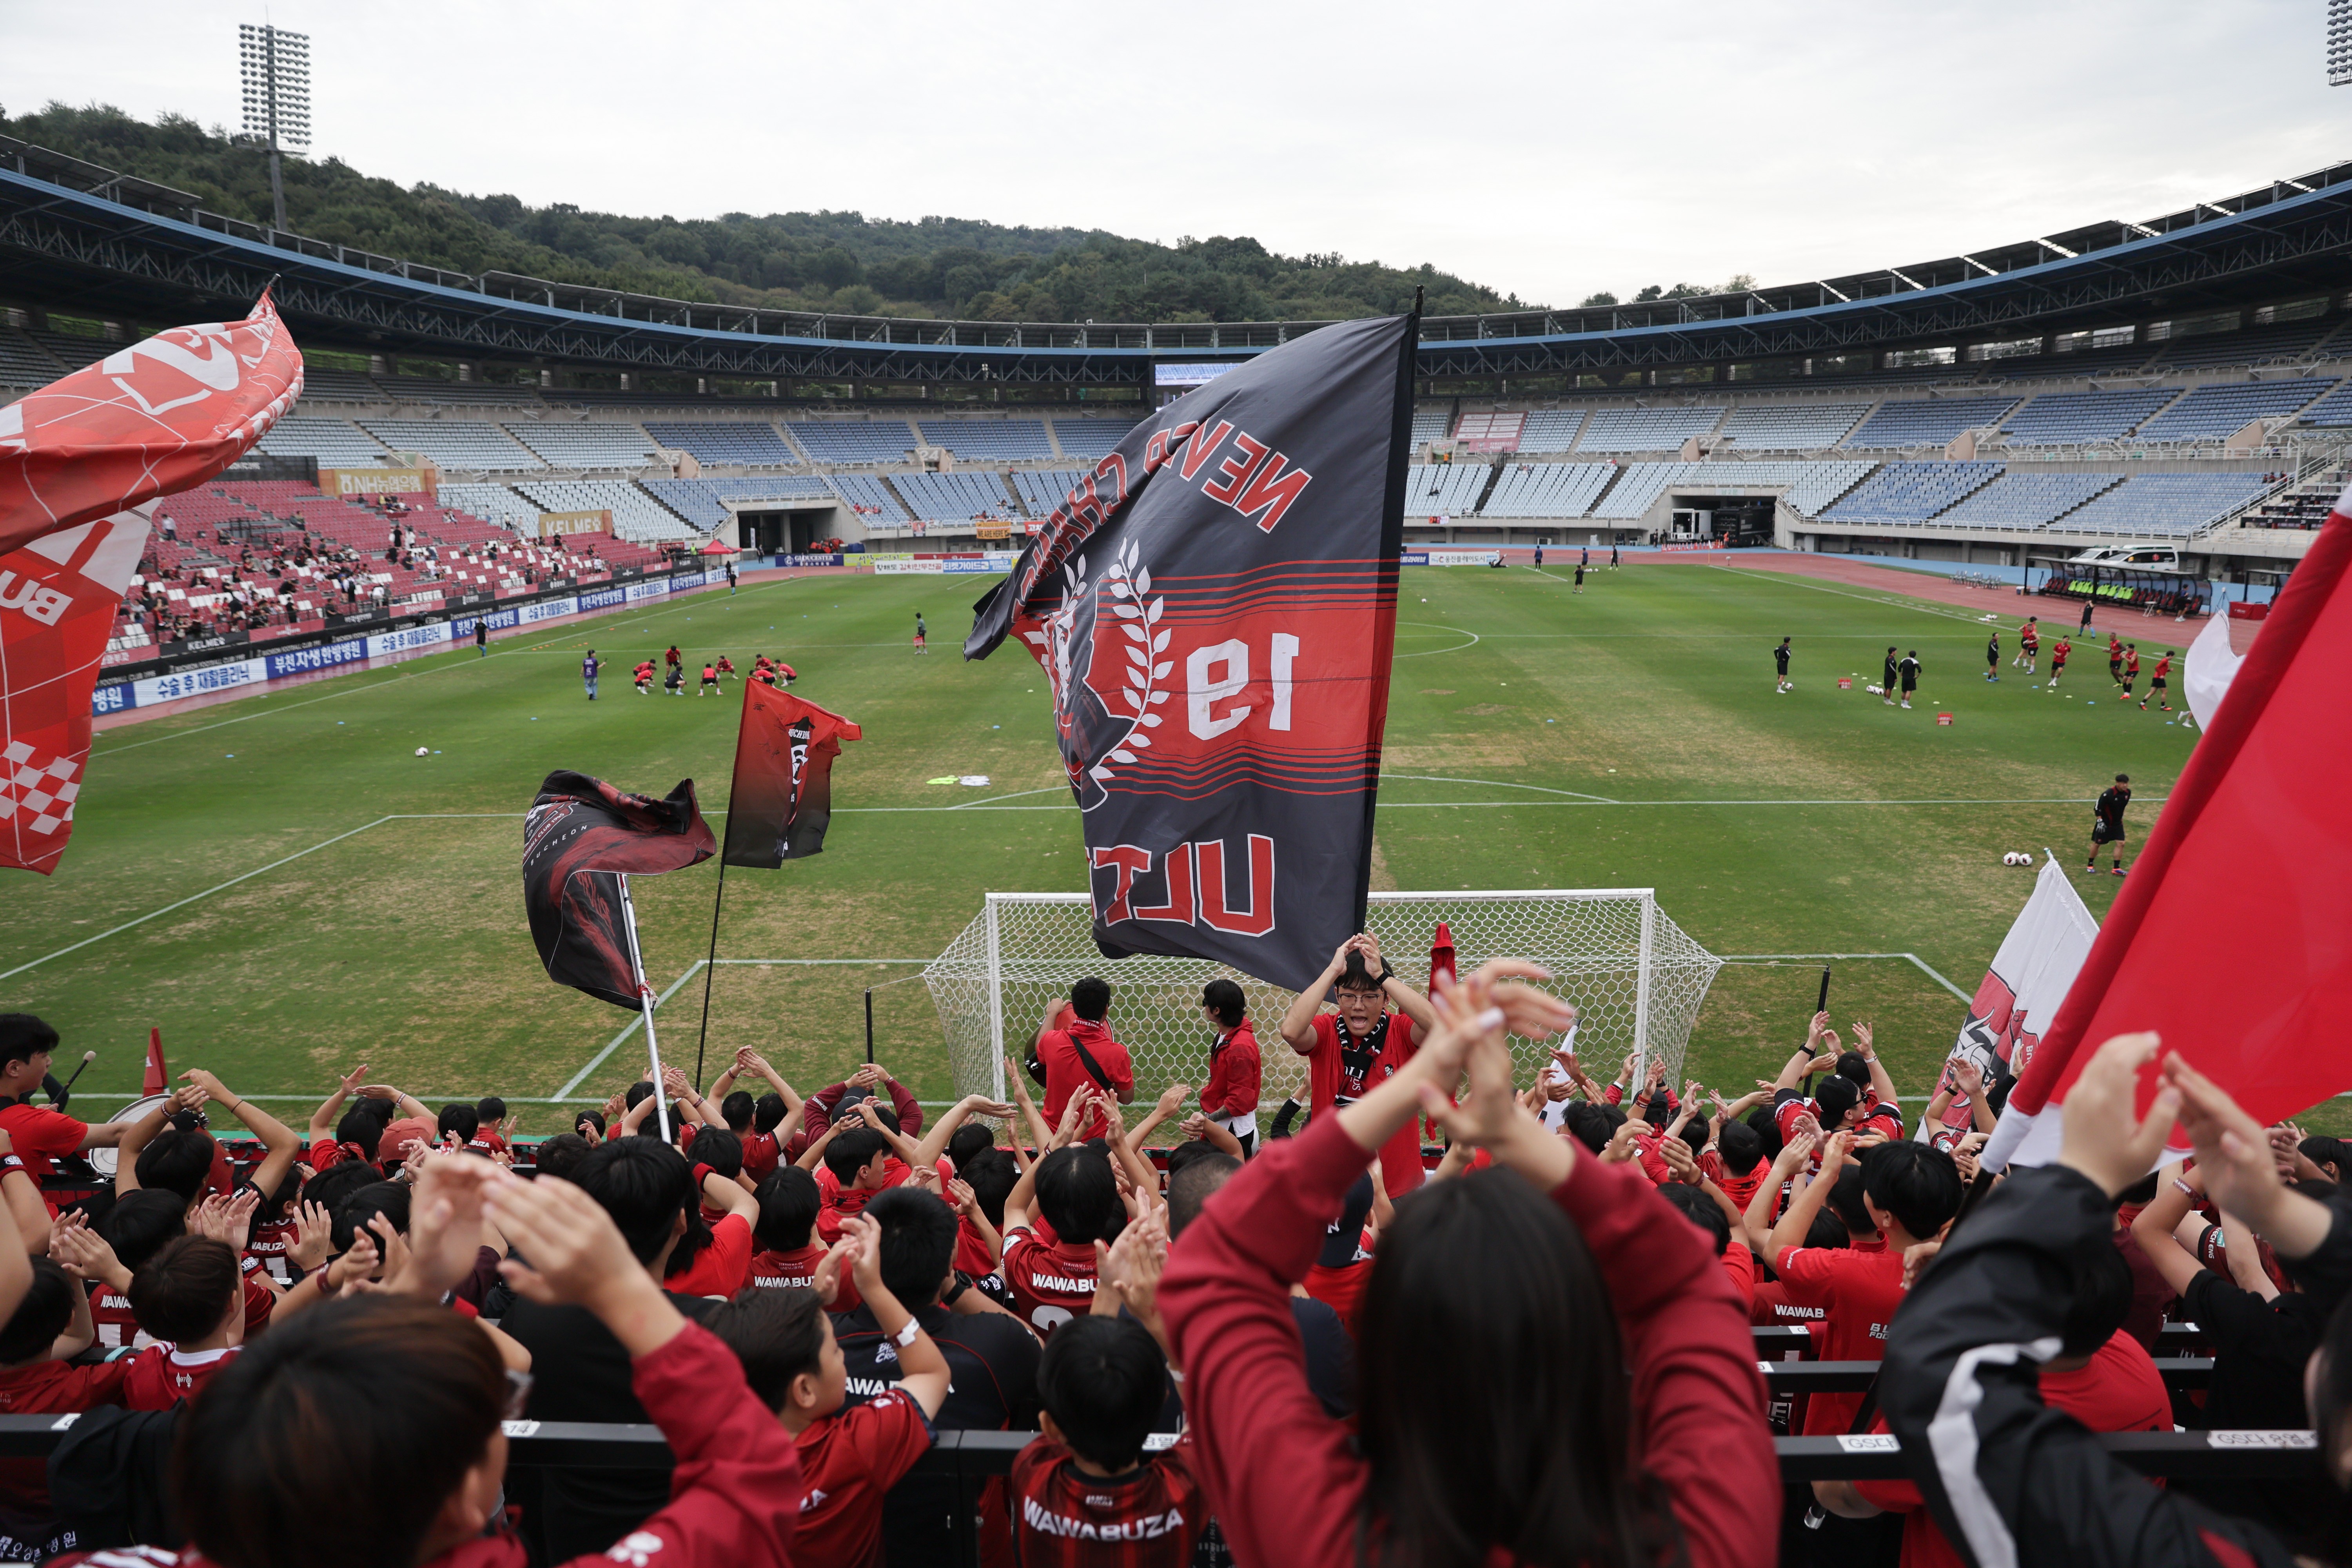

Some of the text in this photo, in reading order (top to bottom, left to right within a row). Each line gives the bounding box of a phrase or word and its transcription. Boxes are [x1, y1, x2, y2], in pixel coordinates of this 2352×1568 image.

[546, 518, 592, 536] KELME
[943, 561, 981, 571] 티켓가이드
[457, 610, 515, 636] 부천자한방병원
[274, 641, 361, 674] 부천자생한방병원
[158, 663, 251, 699] 수술 후 재활클리닉
[523, 838, 537, 860] OOTBALL
[538, 824, 551, 838] CLUB
[530, 825, 587, 866] BUCHEON
[754, 1276, 816, 1288] WAWABU
[1033, 1273, 1100, 1292] WAWABU
[1775, 1304, 1826, 1318] WAWAB
[1024, 1495, 1184, 1541] WAWABUZA
